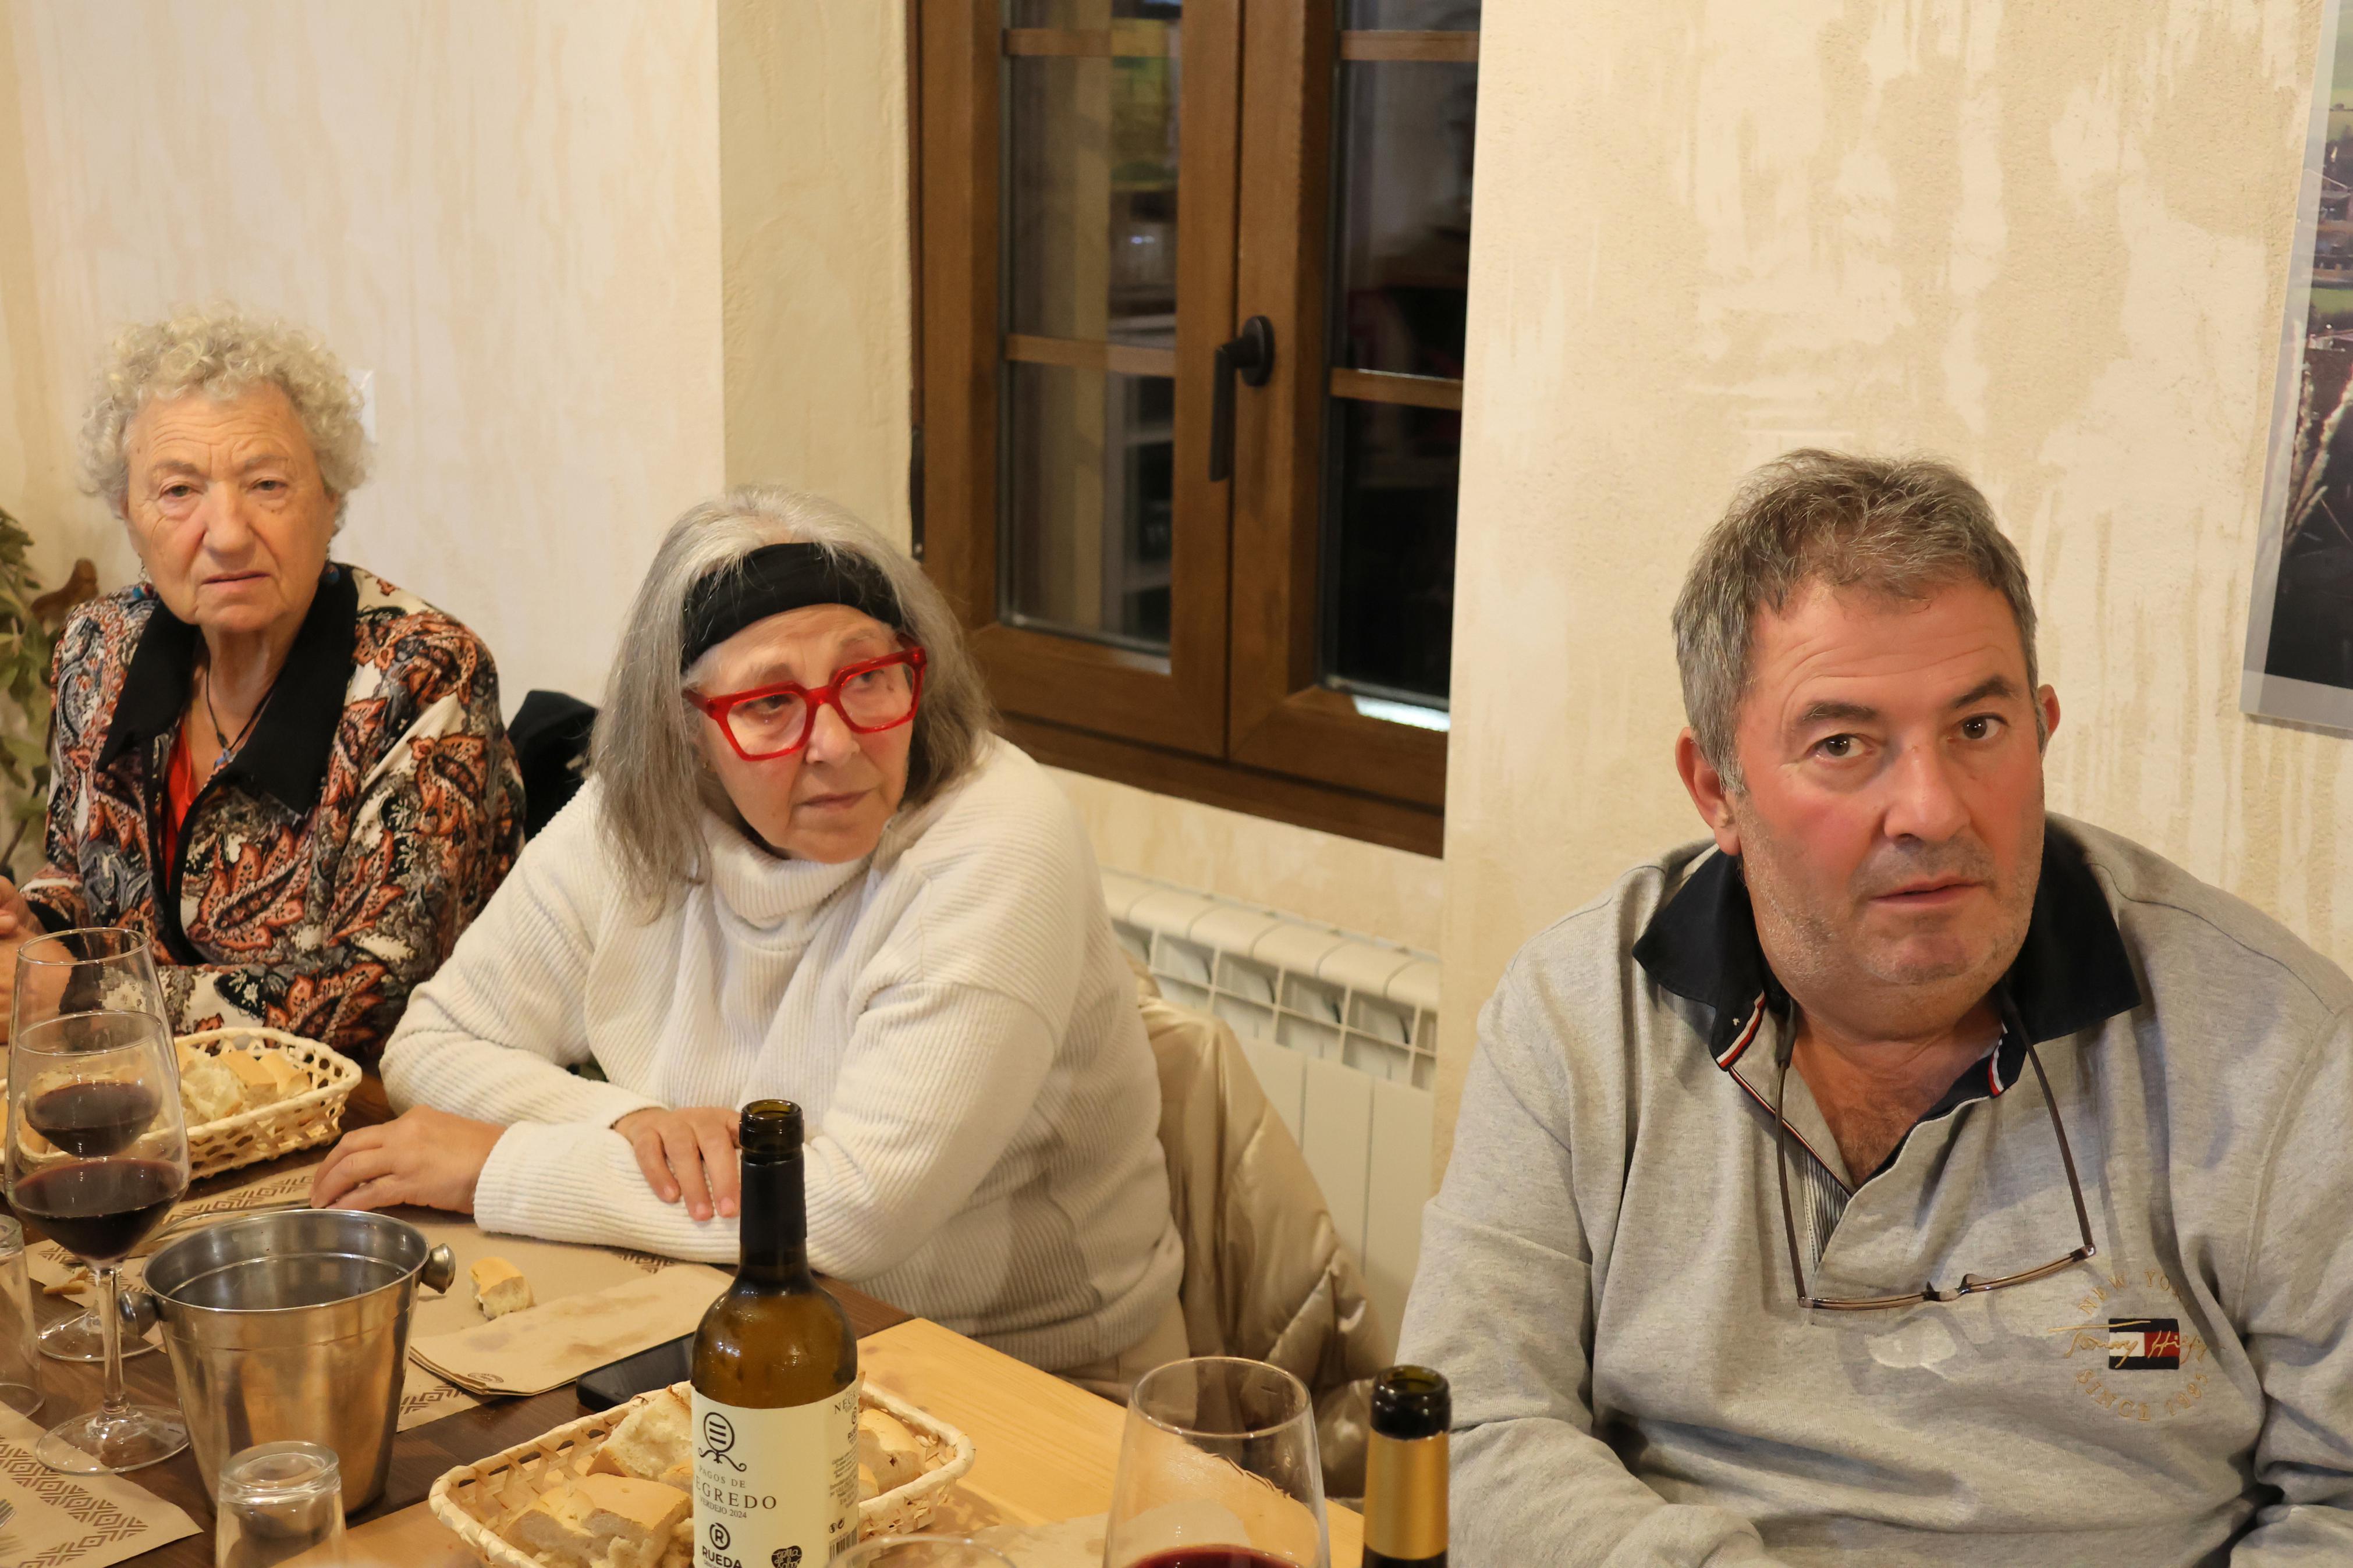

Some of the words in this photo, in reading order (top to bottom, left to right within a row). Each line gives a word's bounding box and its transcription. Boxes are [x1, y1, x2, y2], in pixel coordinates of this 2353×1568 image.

[2077, 1274, 2127, 1316] NEW
[2077, 1370, 2152, 1421] SINCE
[2164, 1373, 2208, 1416] 1985
[699, 1464, 726, 1484] PAGOS
[731, 1478, 746, 1488] DE
[695, 1474, 777, 1510] EGREDO
[700, 1495, 727, 1515] VERDEJO
[729, 1509, 747, 1519] 2024
[702, 1545, 743, 1568] RUEDA
